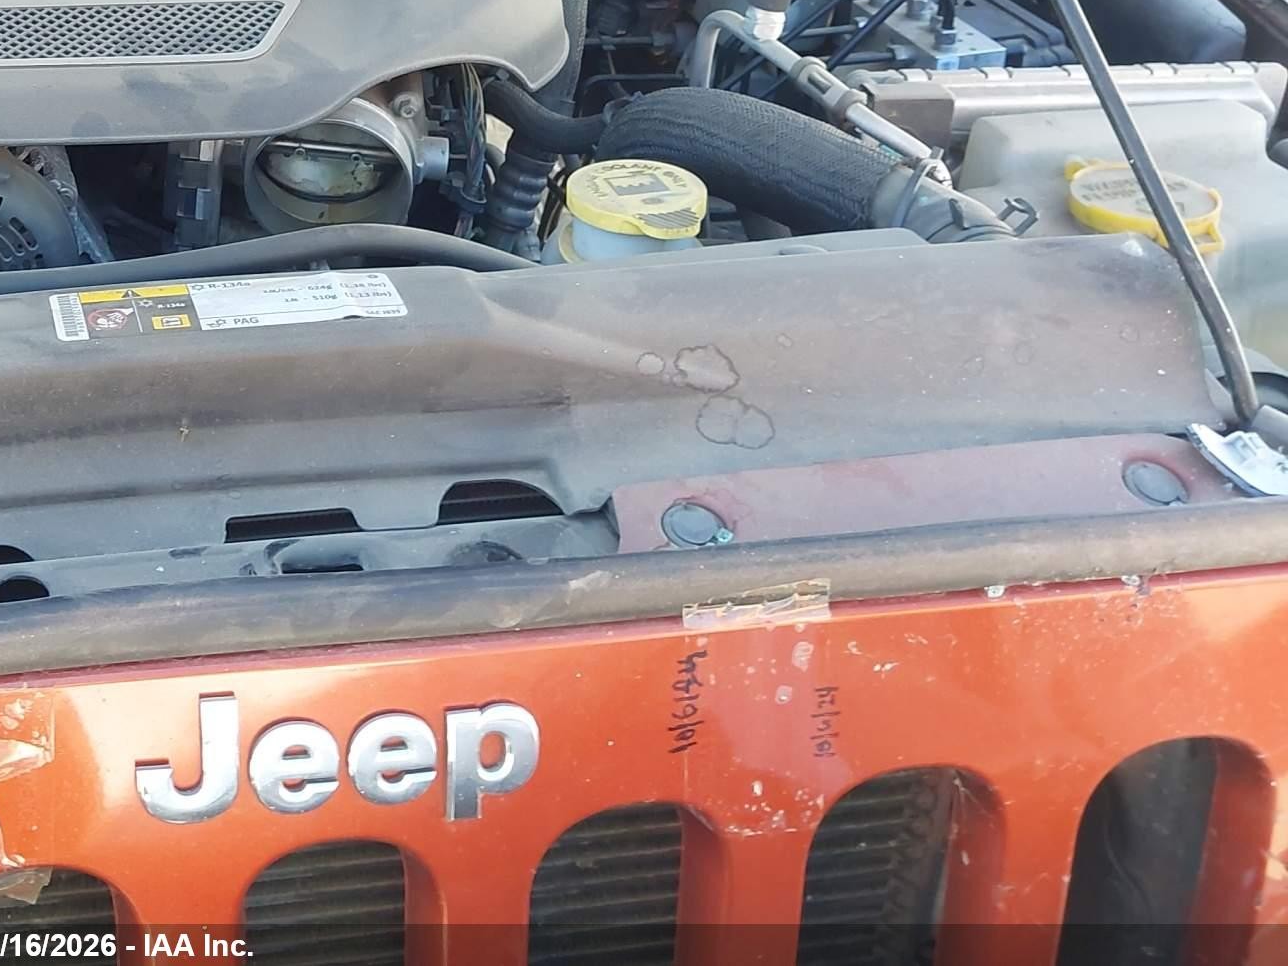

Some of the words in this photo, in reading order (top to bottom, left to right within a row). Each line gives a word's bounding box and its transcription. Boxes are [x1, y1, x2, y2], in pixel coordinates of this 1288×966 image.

[208, 281, 251, 290] R-134a
[233, 316, 260, 325] PAG
[134, 690, 541, 824] Jeep
